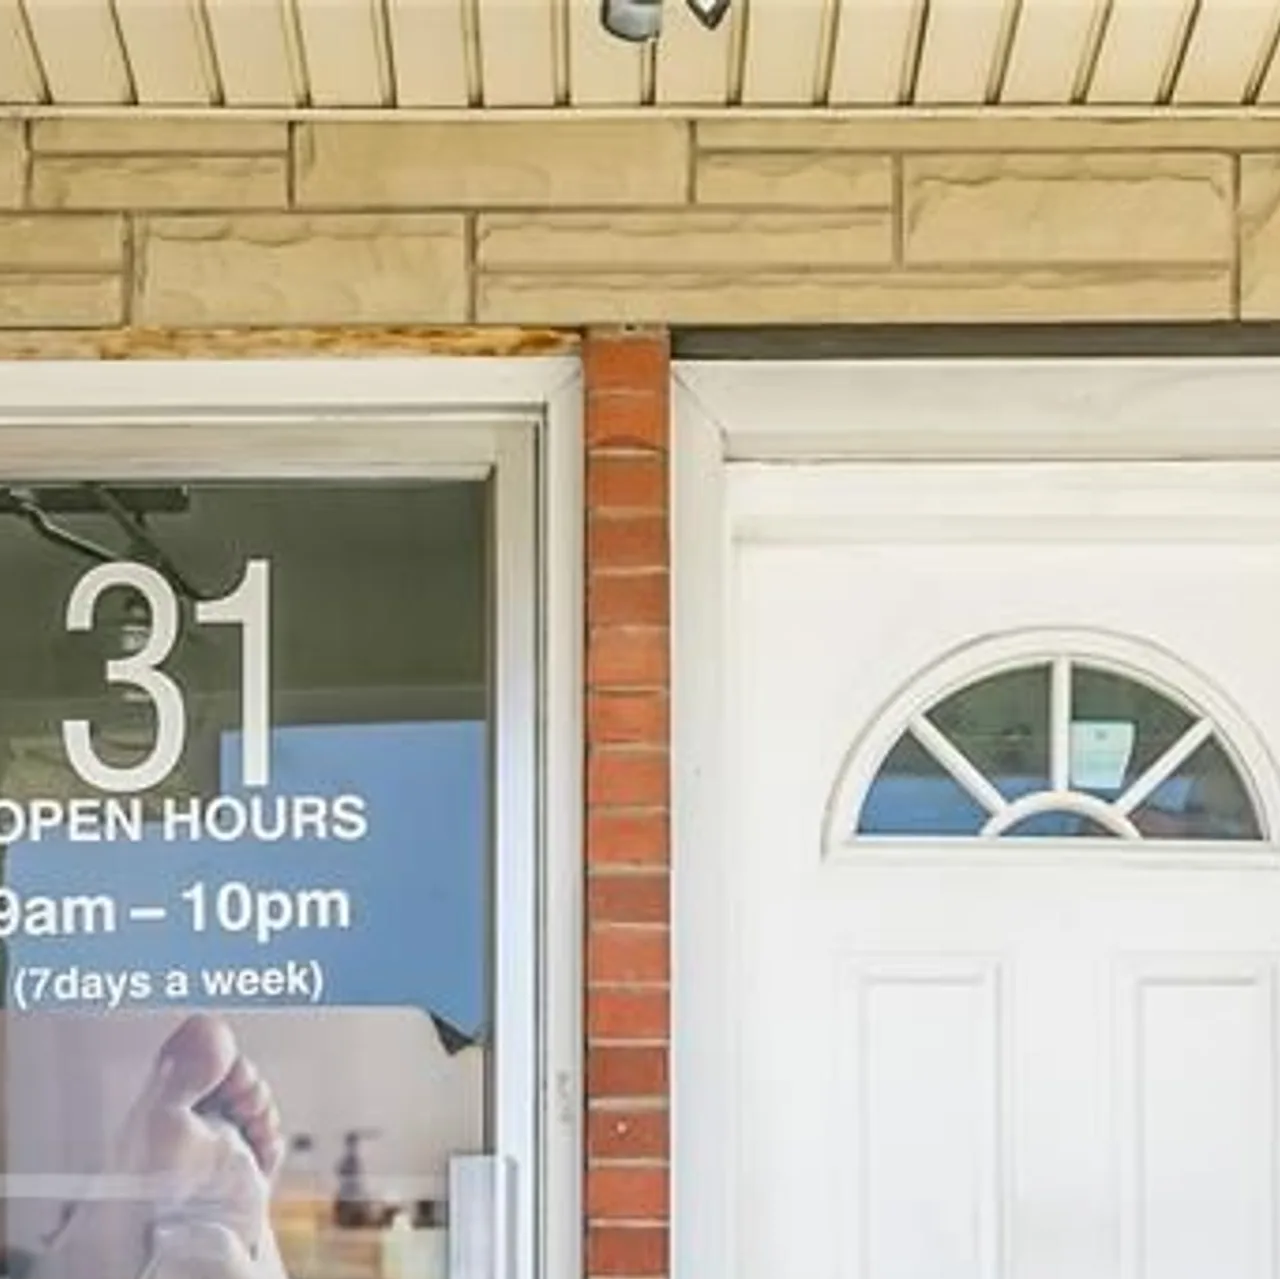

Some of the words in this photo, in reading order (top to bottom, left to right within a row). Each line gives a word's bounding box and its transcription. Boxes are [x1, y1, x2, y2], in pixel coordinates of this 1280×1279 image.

[61, 558, 271, 793] 31
[163, 795, 368, 841] HOURS
[181, 882, 351, 942] 10pm
[14, 966, 152, 1008] (7days
[166, 969, 190, 997] a
[201, 960, 323, 1000] week)
